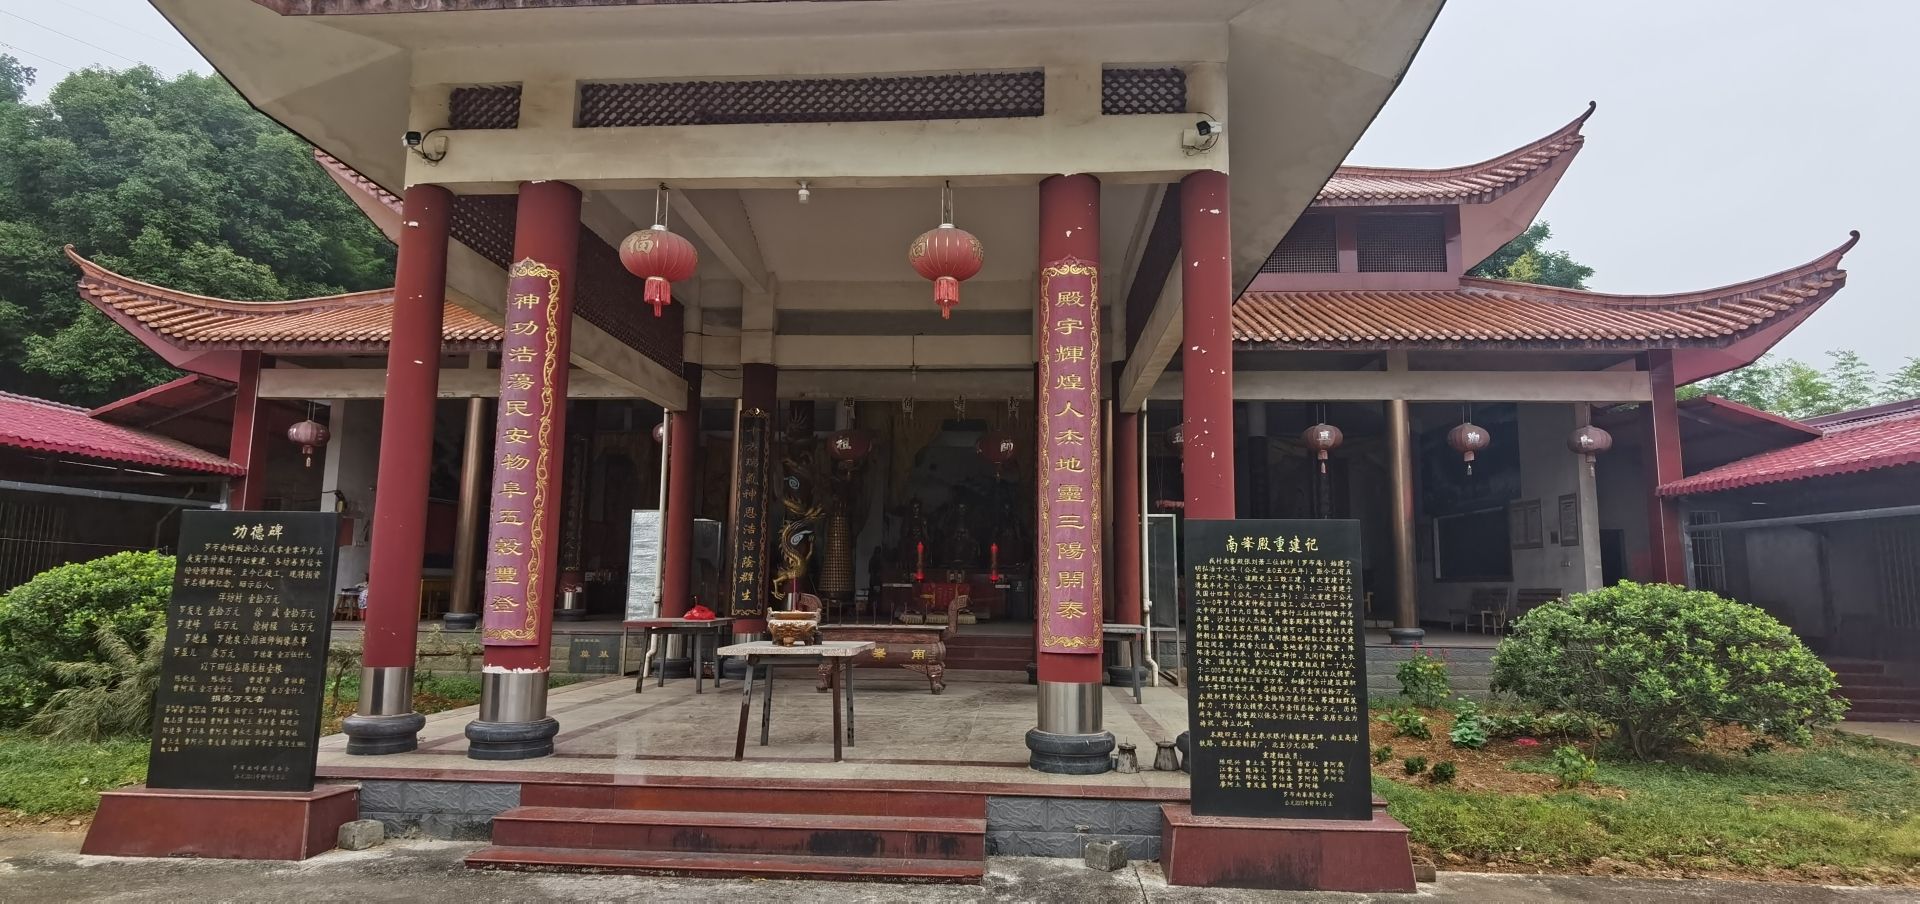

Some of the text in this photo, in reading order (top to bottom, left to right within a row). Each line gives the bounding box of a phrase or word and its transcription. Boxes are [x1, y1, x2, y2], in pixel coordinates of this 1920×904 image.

[627, 229, 656, 255] 福
[232, 523, 283, 540] 功德碑
[1225, 535, 1319, 553] 南峯殿重建记
[248, 594, 280, 605] 壹拾万元
[208, 606, 240, 617] 壹拾万元
[284, 608, 316, 618] 壹拾万元
[214, 621, 239, 631] 伍万元
[290, 623, 315, 632] 伍万元
